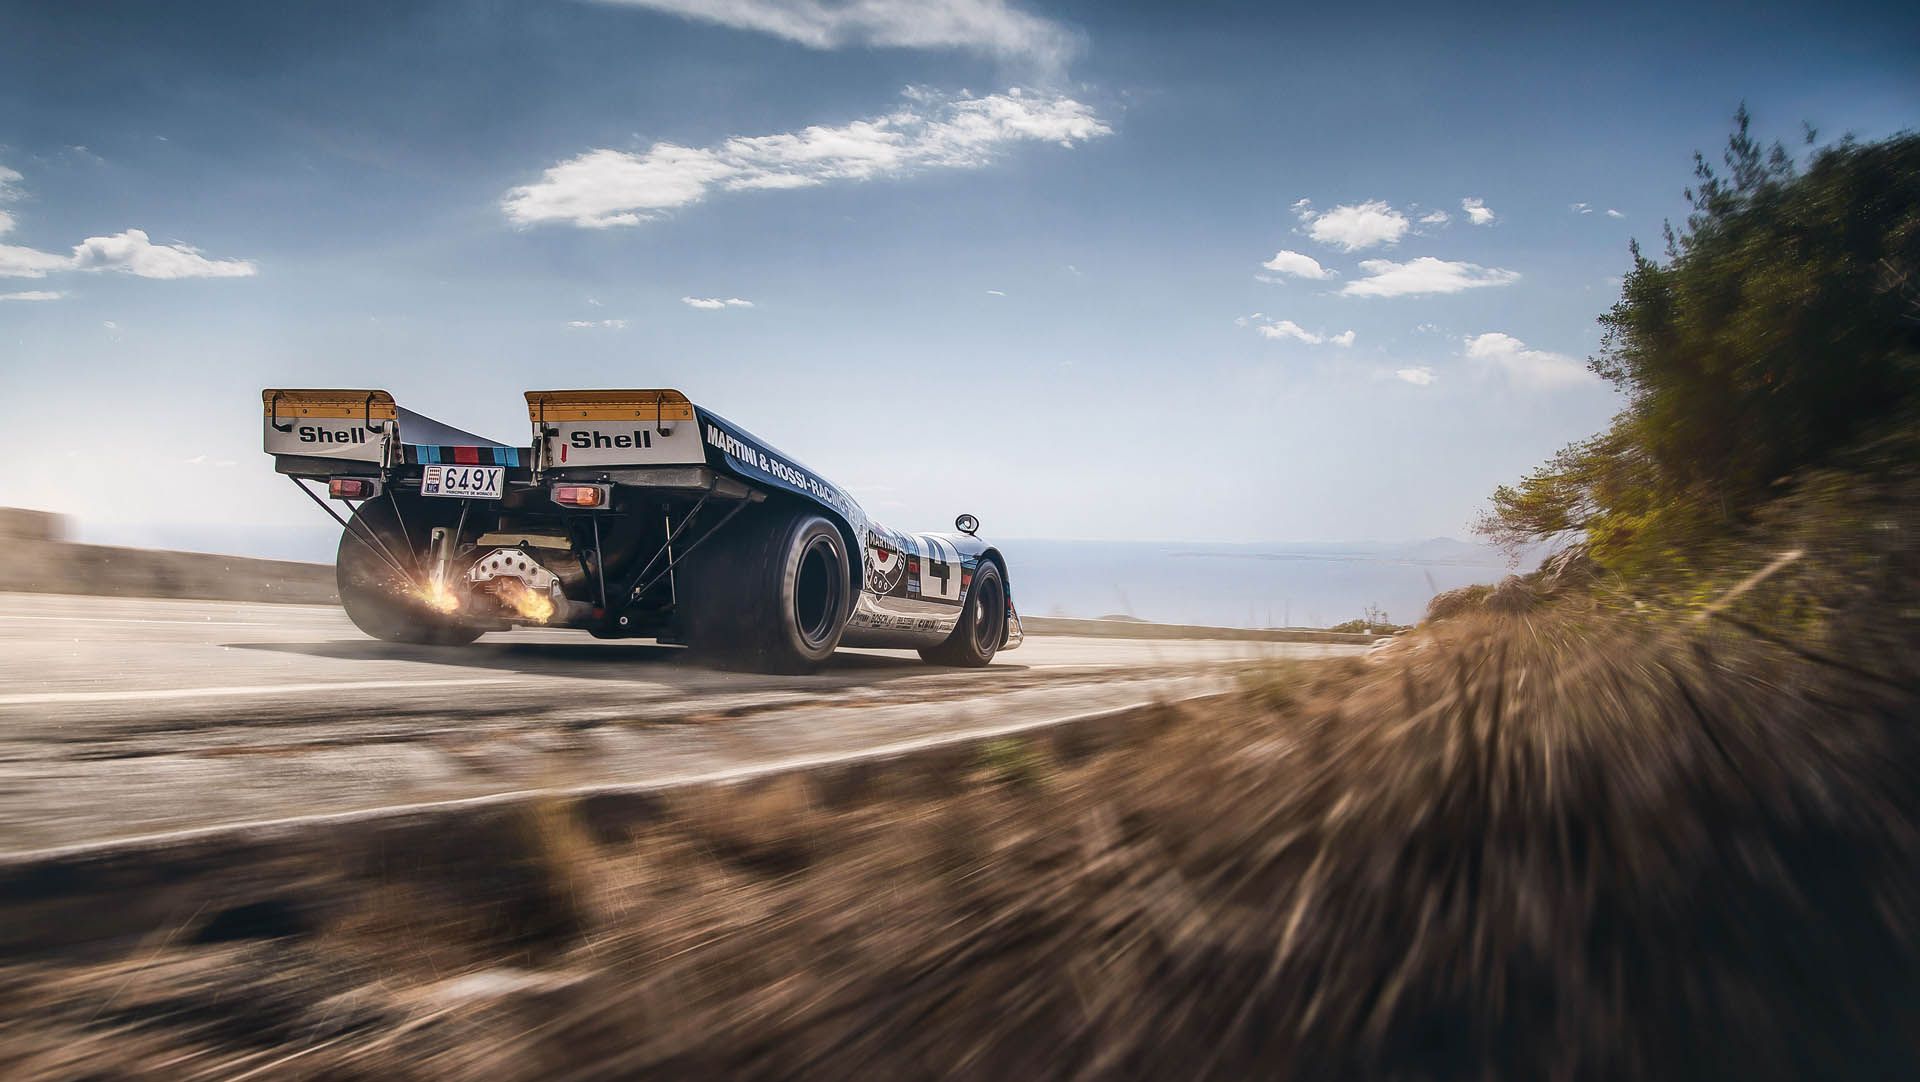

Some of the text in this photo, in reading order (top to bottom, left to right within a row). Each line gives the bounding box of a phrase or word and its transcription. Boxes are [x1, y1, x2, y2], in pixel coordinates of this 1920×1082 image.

[299, 426, 366, 444] Shell
[570, 430, 652, 449] Shell
[707, 424, 758, 467] MARTINI
[759, 453, 770, 473] &
[445, 468, 498, 491] 649X
[869, 530, 897, 551] MARTINI
